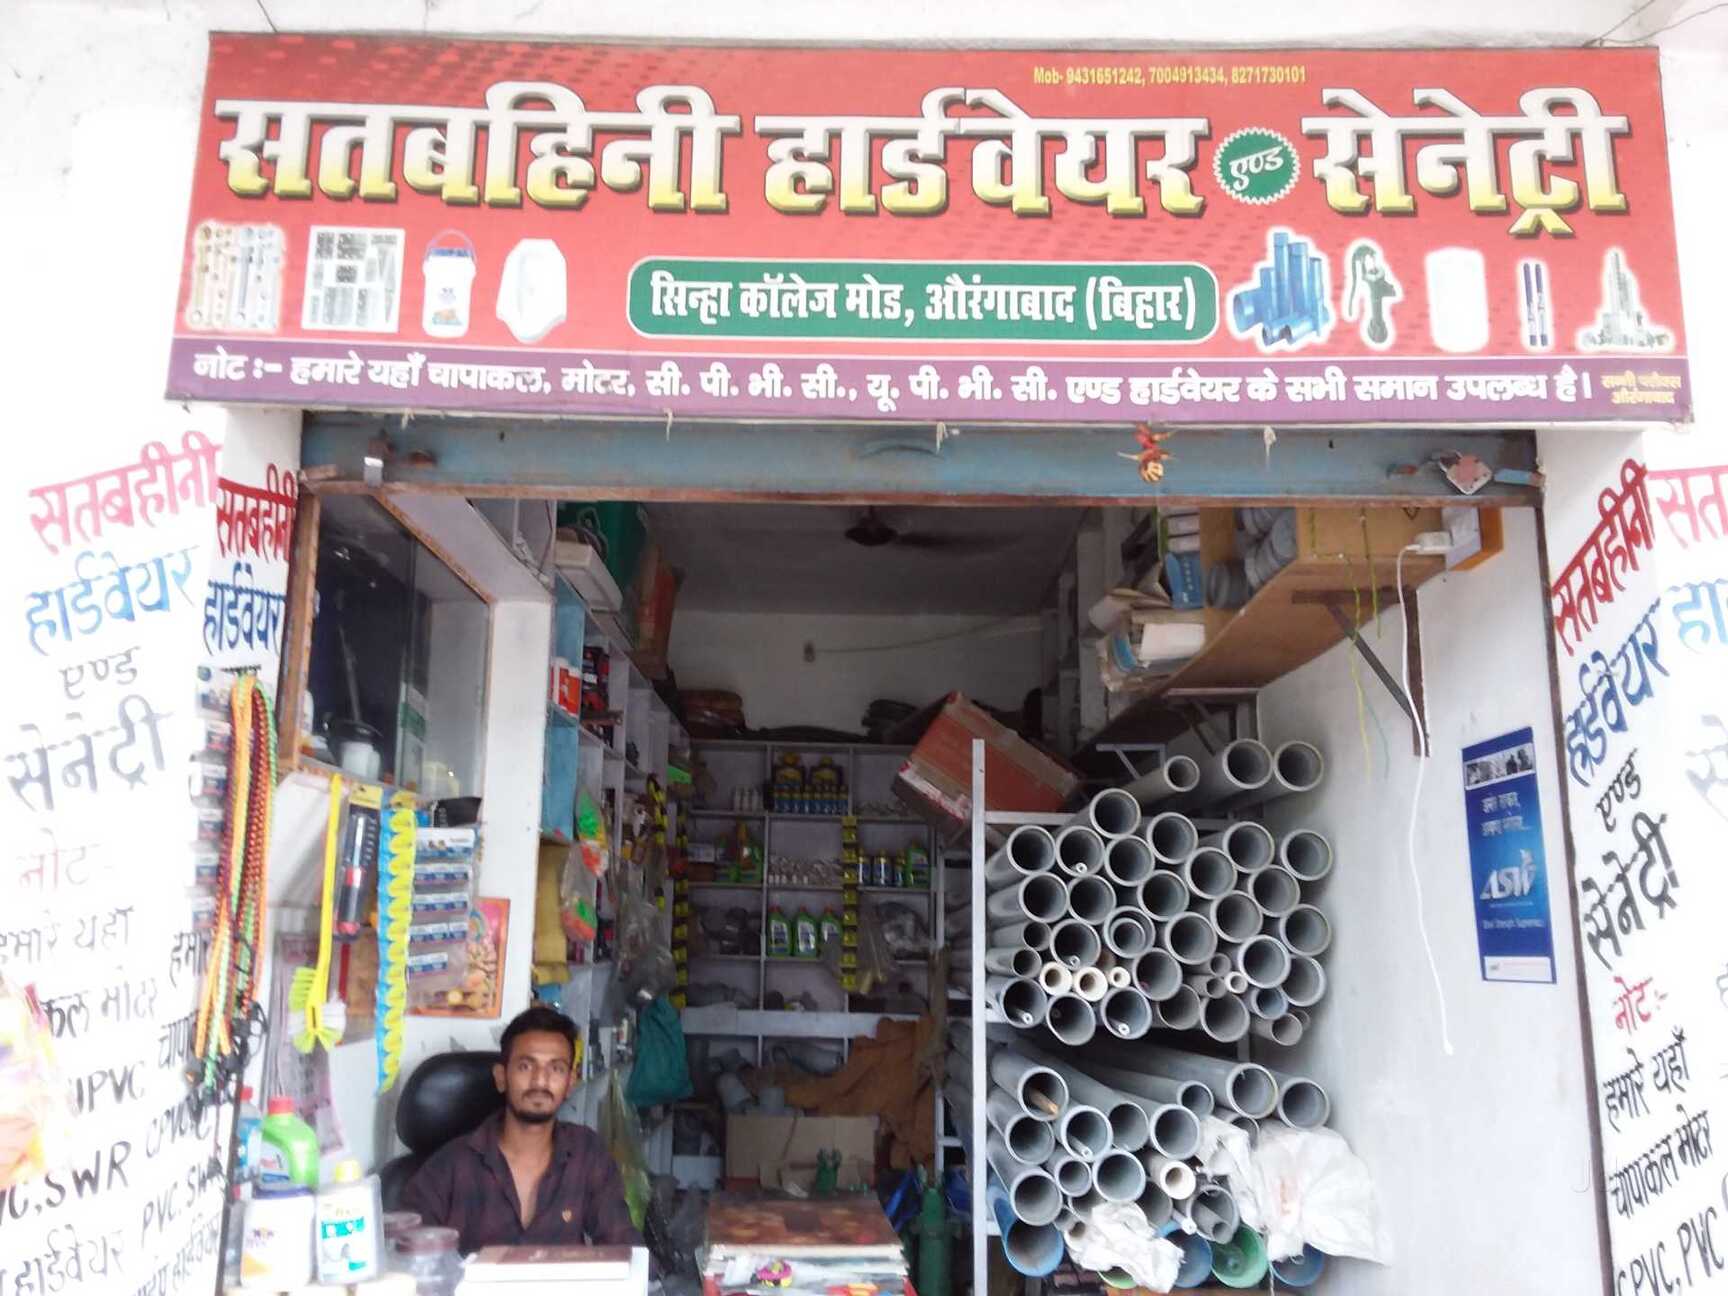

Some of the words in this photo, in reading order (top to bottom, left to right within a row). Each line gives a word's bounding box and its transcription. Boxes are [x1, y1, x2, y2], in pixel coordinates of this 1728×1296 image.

[1231, 66, 1306, 83] 8271730101
[215, 80, 741, 212] सतबहिनी
[754, 87, 1210, 216] हार्डवेयर
[1229, 145, 1284, 191] एण्ड
[1301, 87, 1630, 237] सेनेट्री
[650, 270, 733, 325] सिन्हा
[739, 272, 839, 319] कॉलेज
[925, 273, 1076, 323] औरंगाबाद
[1086, 276, 1196, 330] (बिहार)
[290, 350, 363, 385] हमारे
[367, 351, 426, 389] यहाँ
[1065, 377, 1123, 404] एण्ड
[1128, 367, 1242, 405] हार्डवेयर
[1246, 367, 1279, 402] के
[1284, 365, 1347, 401] सभी
[1444, 374, 1548, 401] उपलब्ध
